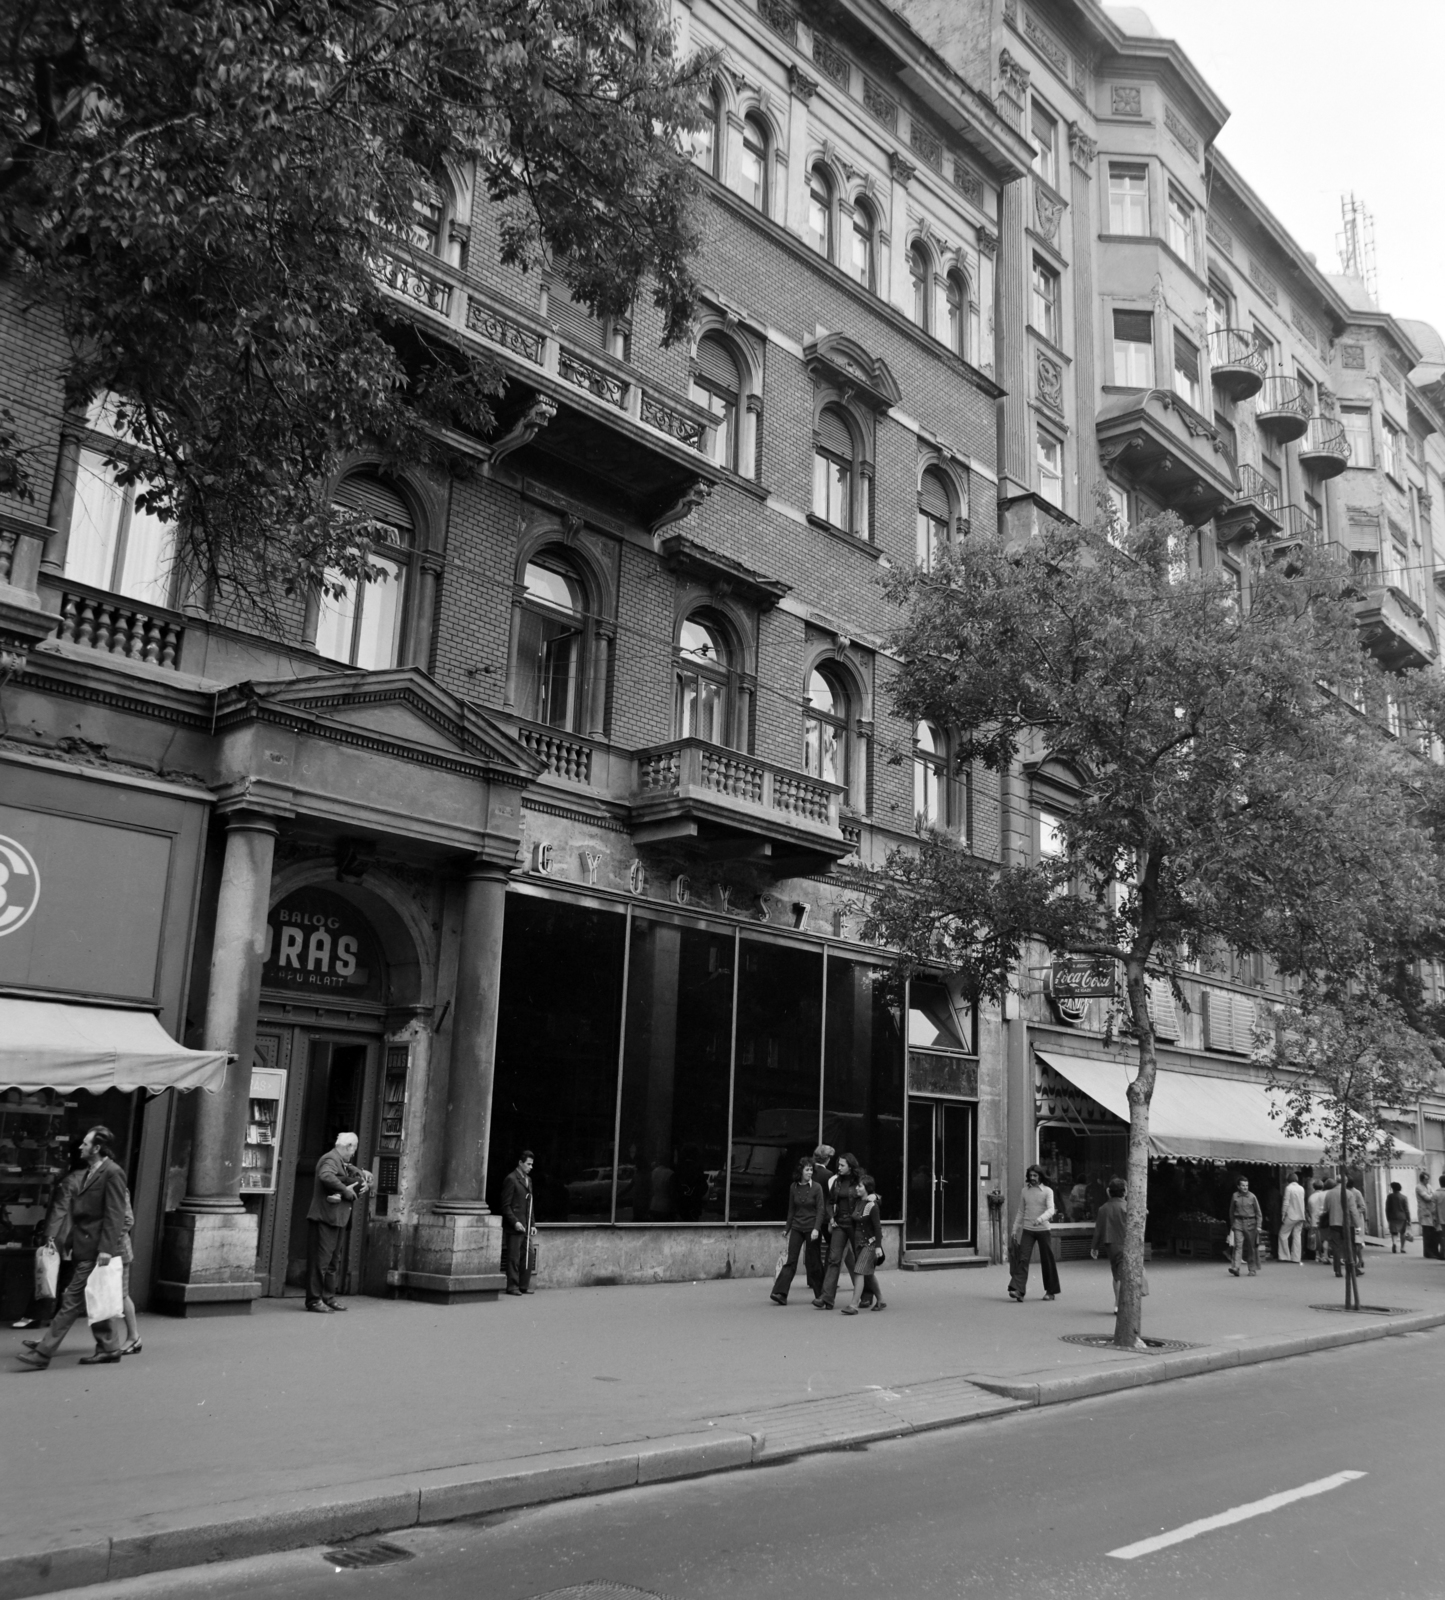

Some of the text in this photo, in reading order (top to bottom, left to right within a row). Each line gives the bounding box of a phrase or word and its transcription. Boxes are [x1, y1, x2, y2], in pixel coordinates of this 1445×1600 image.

[280, 909, 340, 929] BALOG
[309, 974, 344, 987] ALATT
[250, 1076, 267, 1091] ÁS
